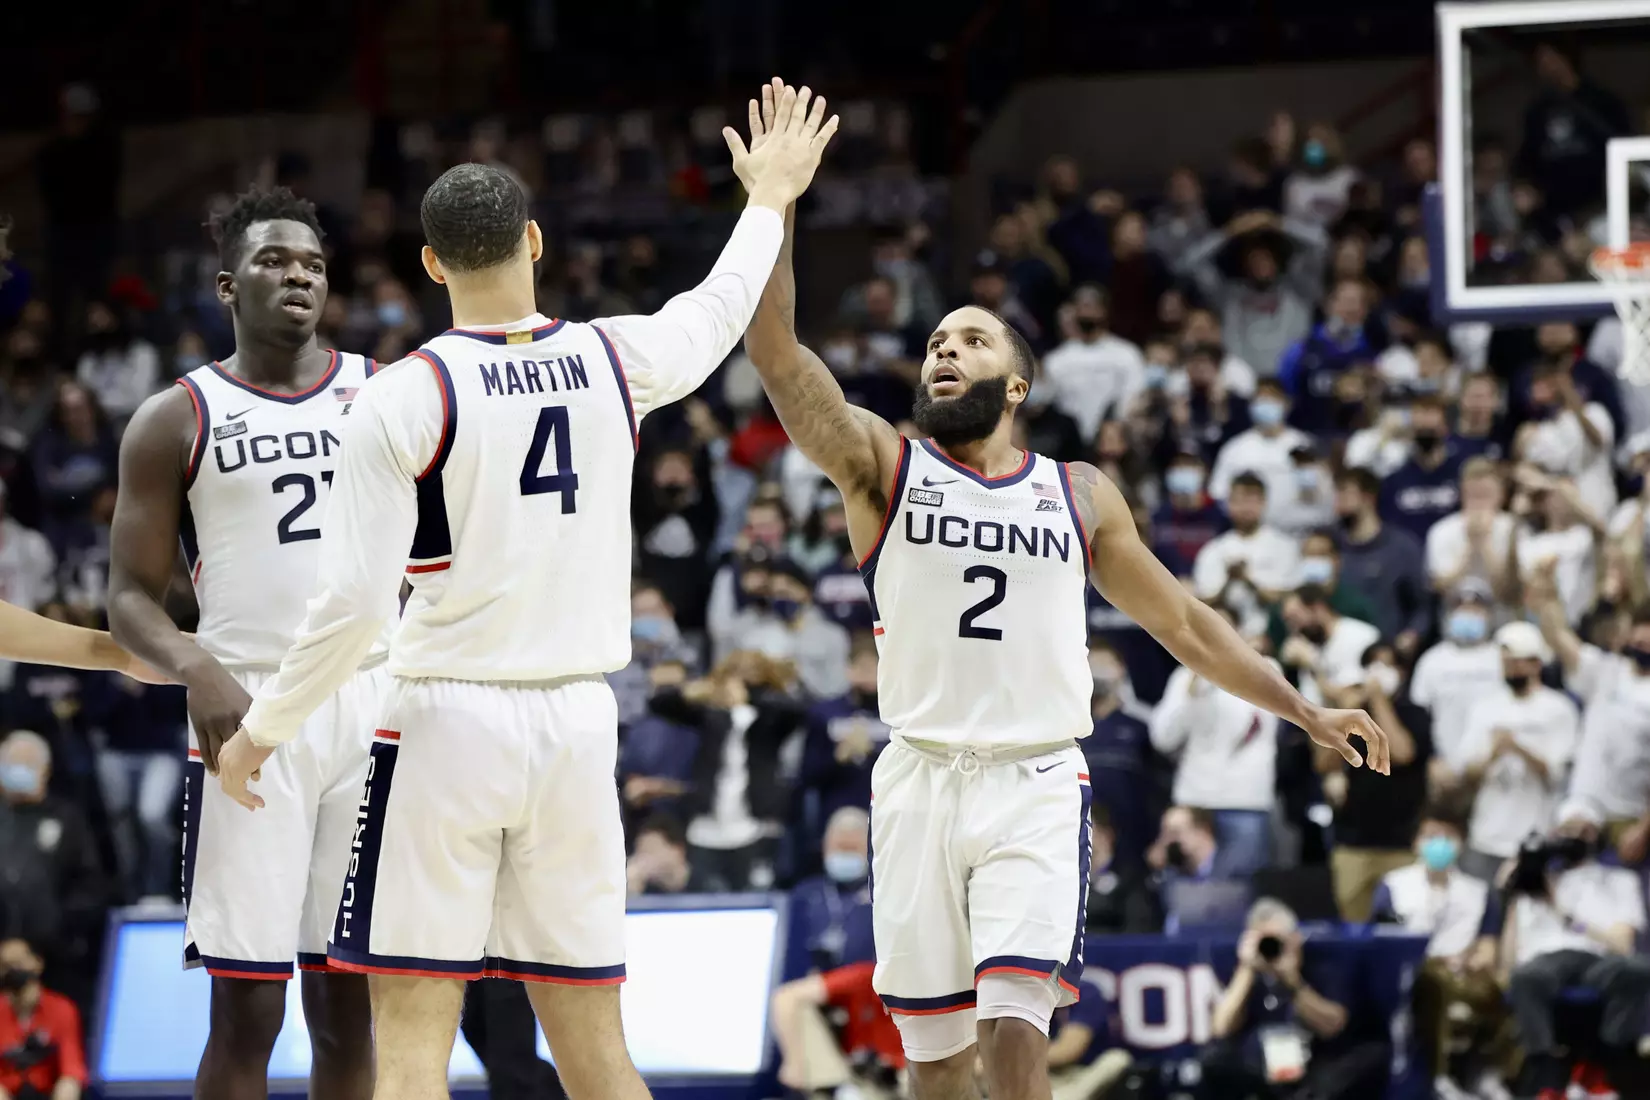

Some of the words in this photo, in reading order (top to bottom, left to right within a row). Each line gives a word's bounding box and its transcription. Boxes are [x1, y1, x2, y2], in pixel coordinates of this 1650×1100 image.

[479, 354, 589, 396] MARTIN
[519, 405, 579, 514] 4
[909, 496, 941, 506] CHANGE
[1036, 504, 1064, 512] EAST
[906, 511, 1070, 562] UCONN
[958, 564, 1008, 641] 2
